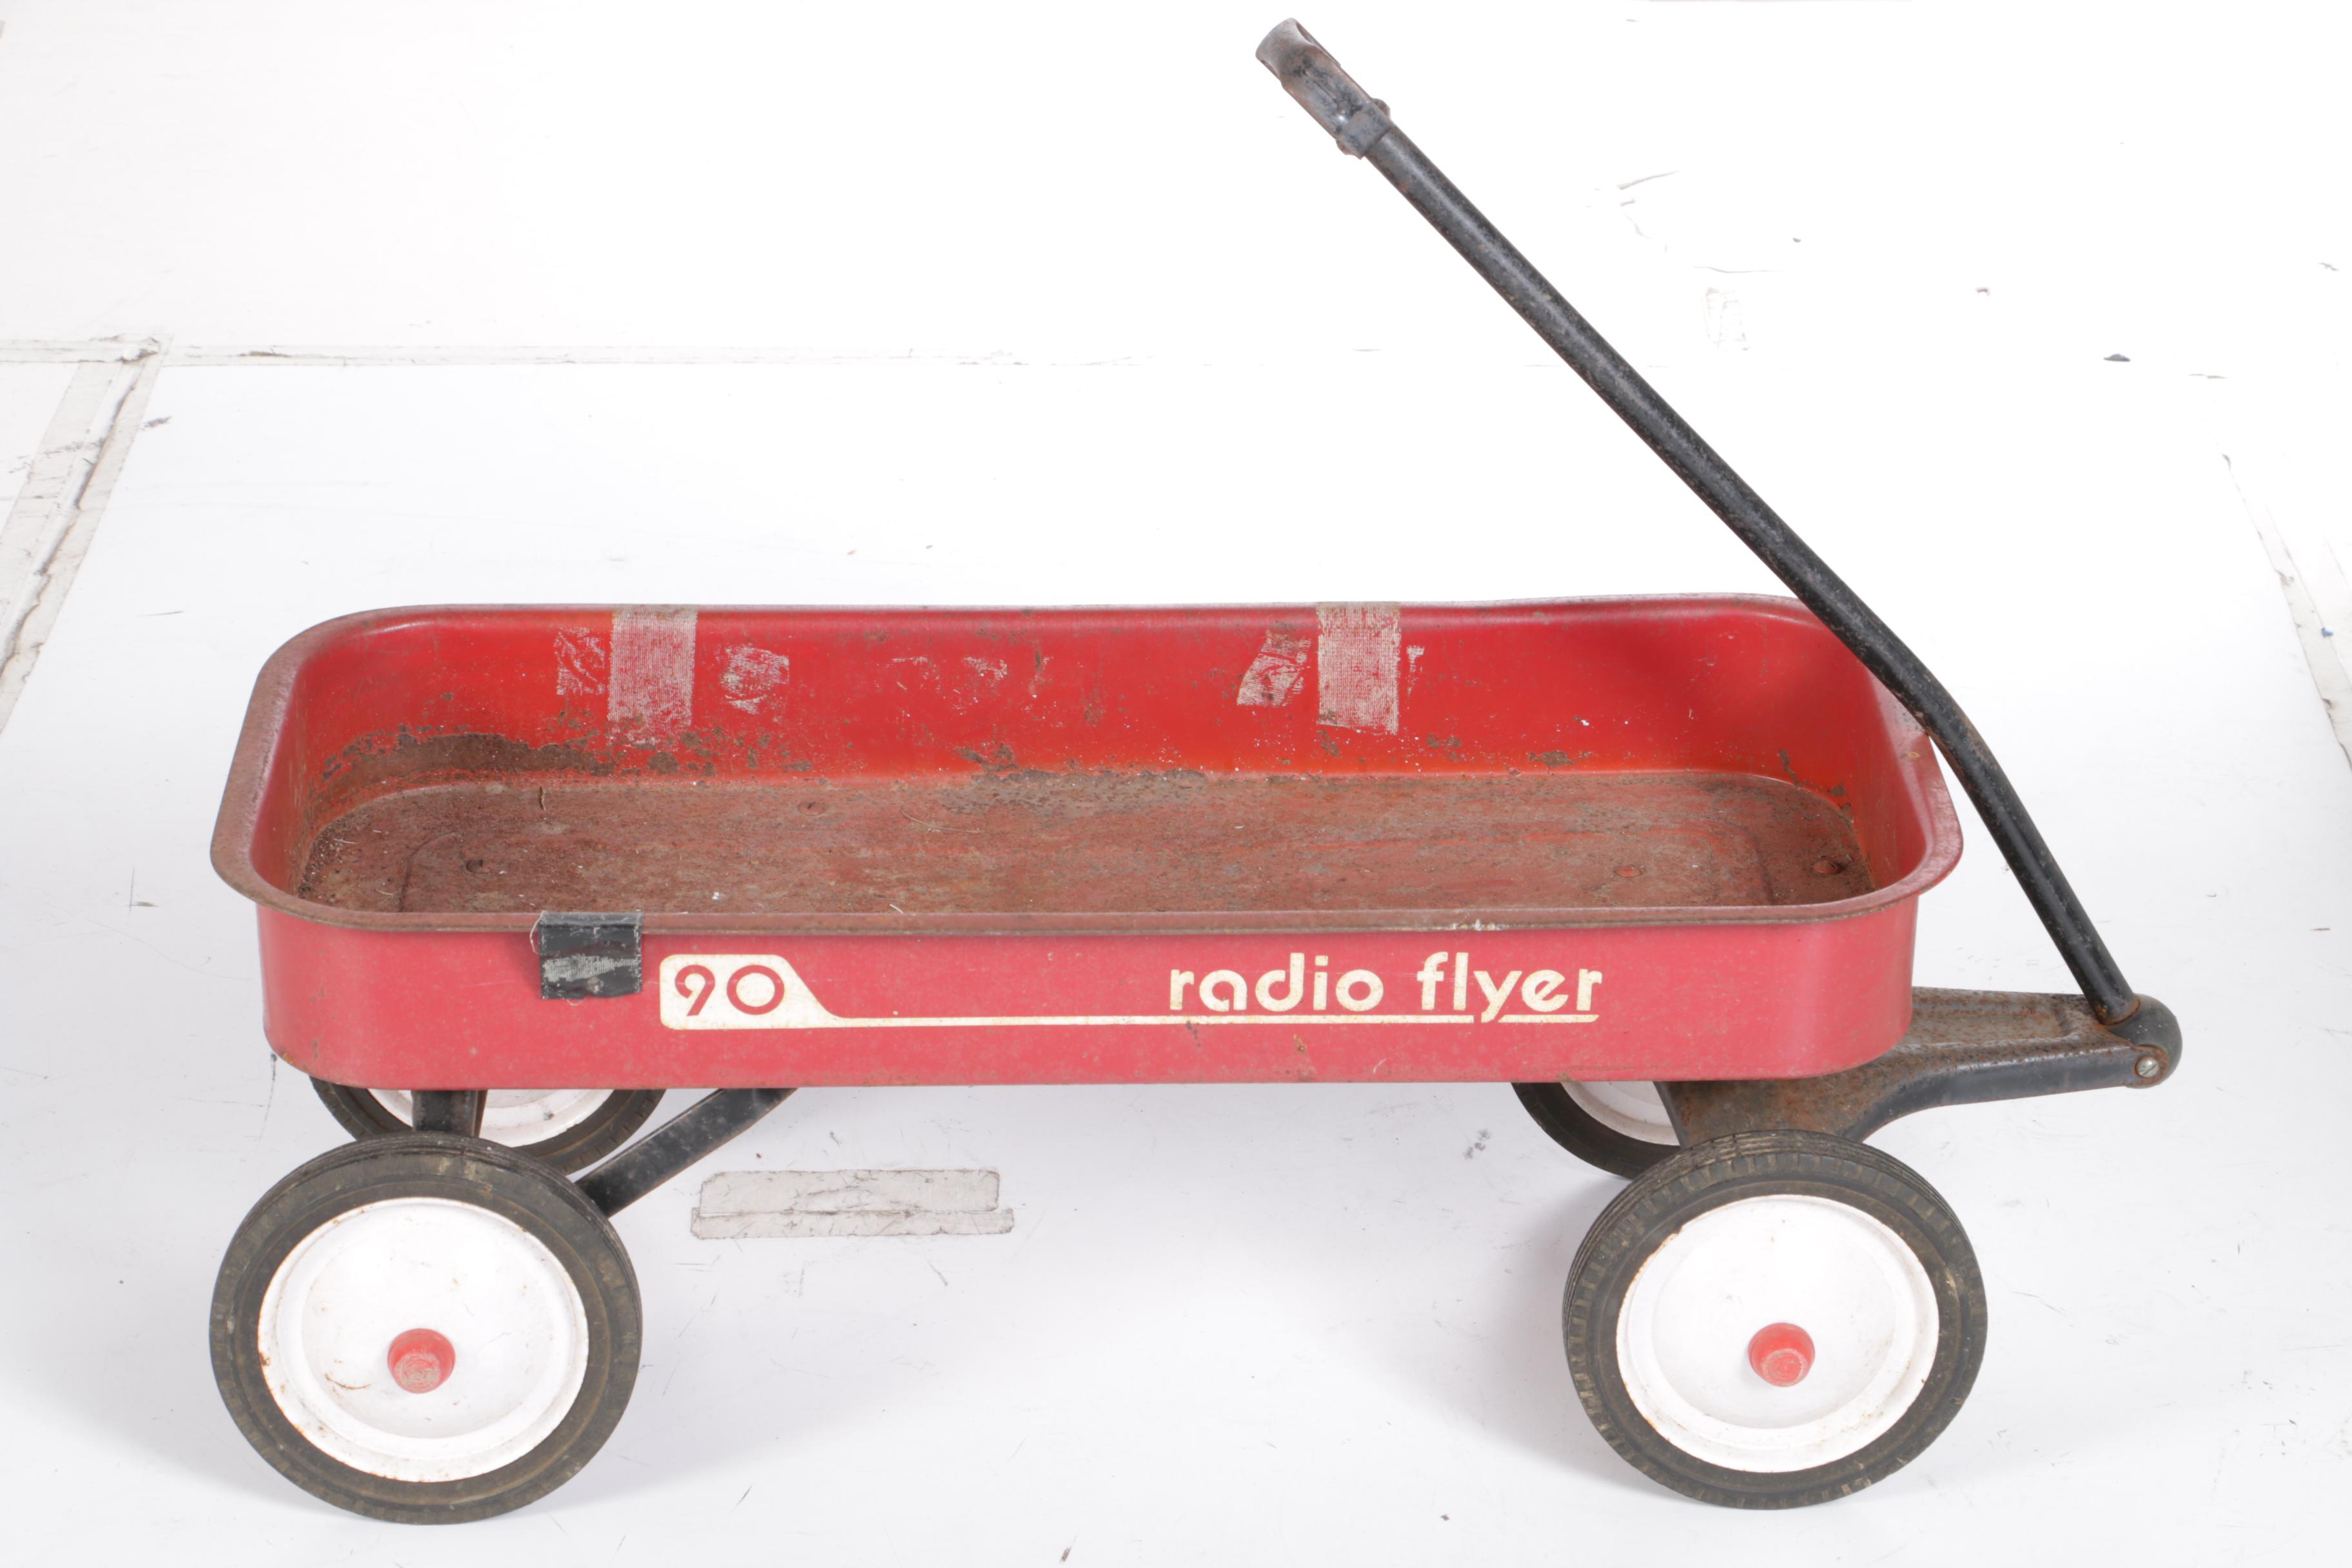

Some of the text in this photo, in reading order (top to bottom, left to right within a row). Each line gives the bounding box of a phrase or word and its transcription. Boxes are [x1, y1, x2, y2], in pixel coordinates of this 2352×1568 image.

[674, 964, 785, 1017] 90
[1170, 951, 1603, 1023] radio flyer
